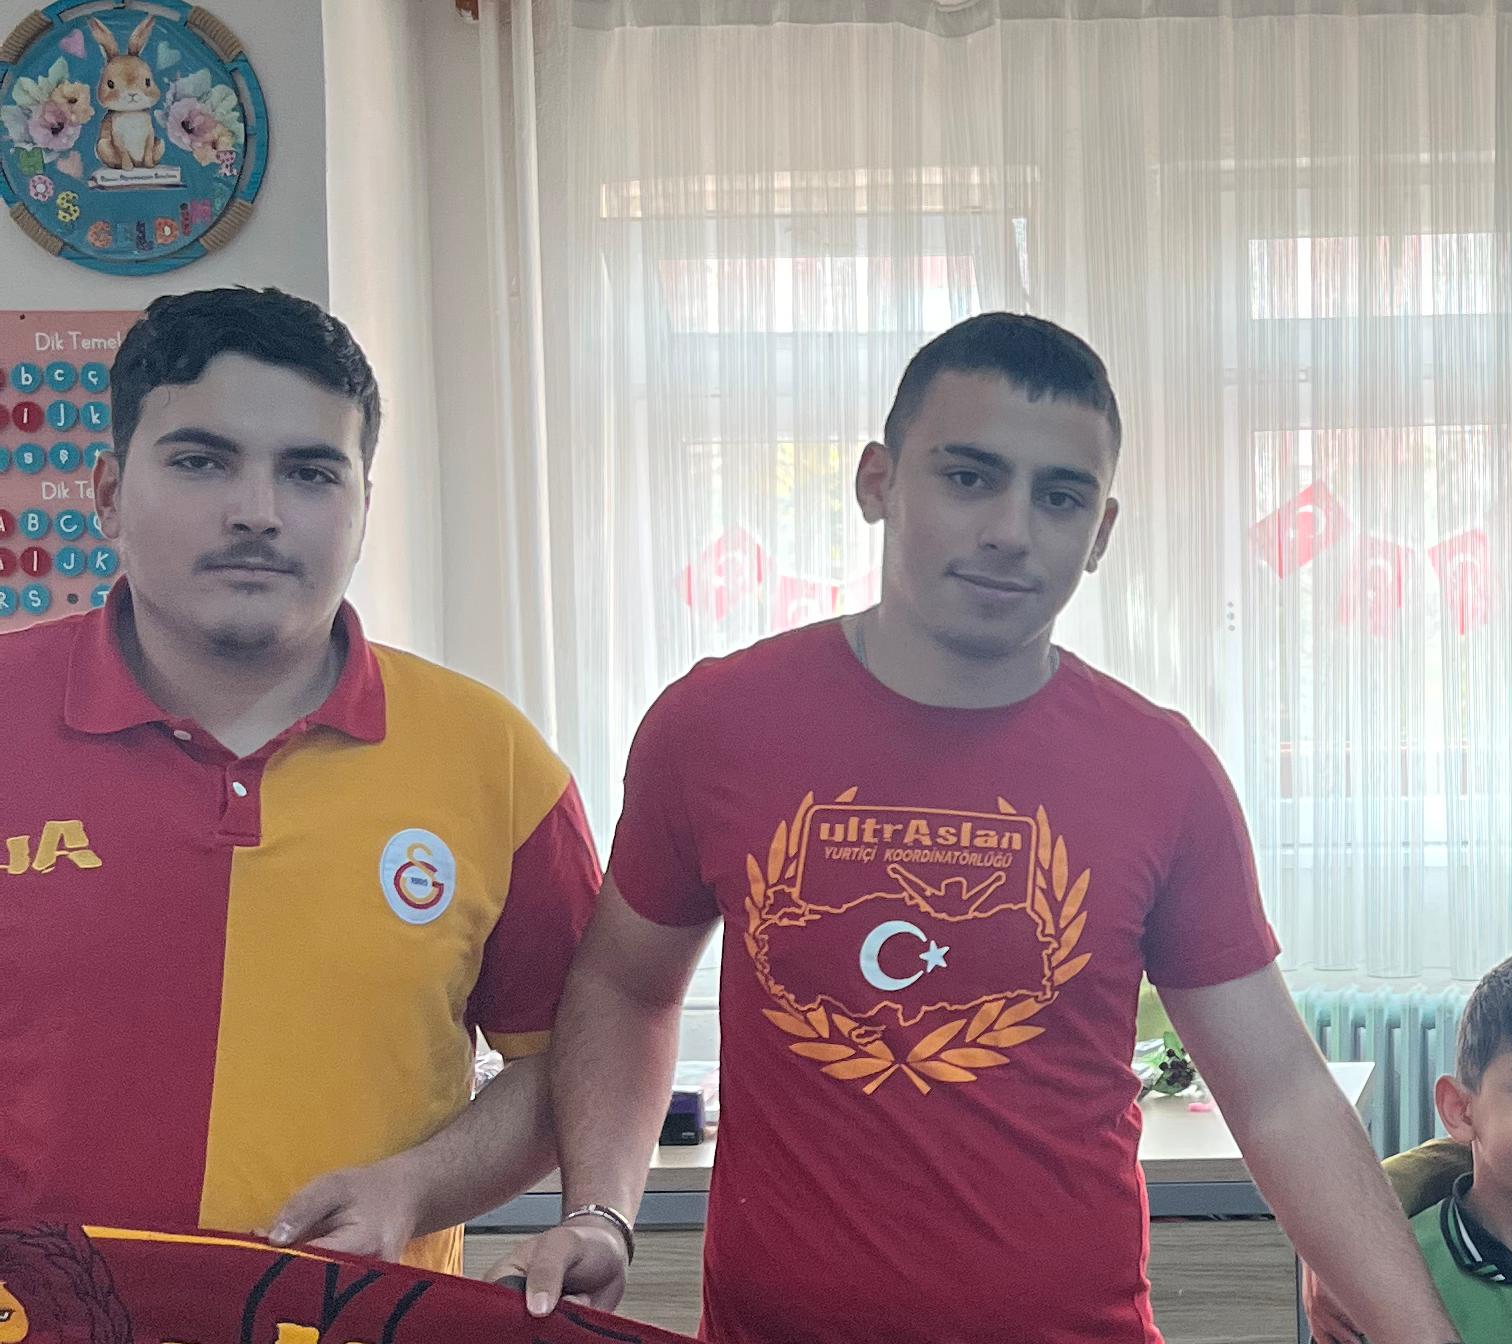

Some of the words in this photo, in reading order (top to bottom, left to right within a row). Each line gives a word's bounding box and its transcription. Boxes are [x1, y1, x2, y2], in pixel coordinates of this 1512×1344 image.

[21, 366, 33, 385] b
[54, 369, 65, 381] c
[89, 405, 101, 424] k
[27, 513, 39, 531] B
[59, 515, 78, 532] C
[63, 552, 75, 570] J
[95, 551, 110, 570] K
[28, 589, 41, 607] S
[819, 816, 1023, 850] ultrAslan
